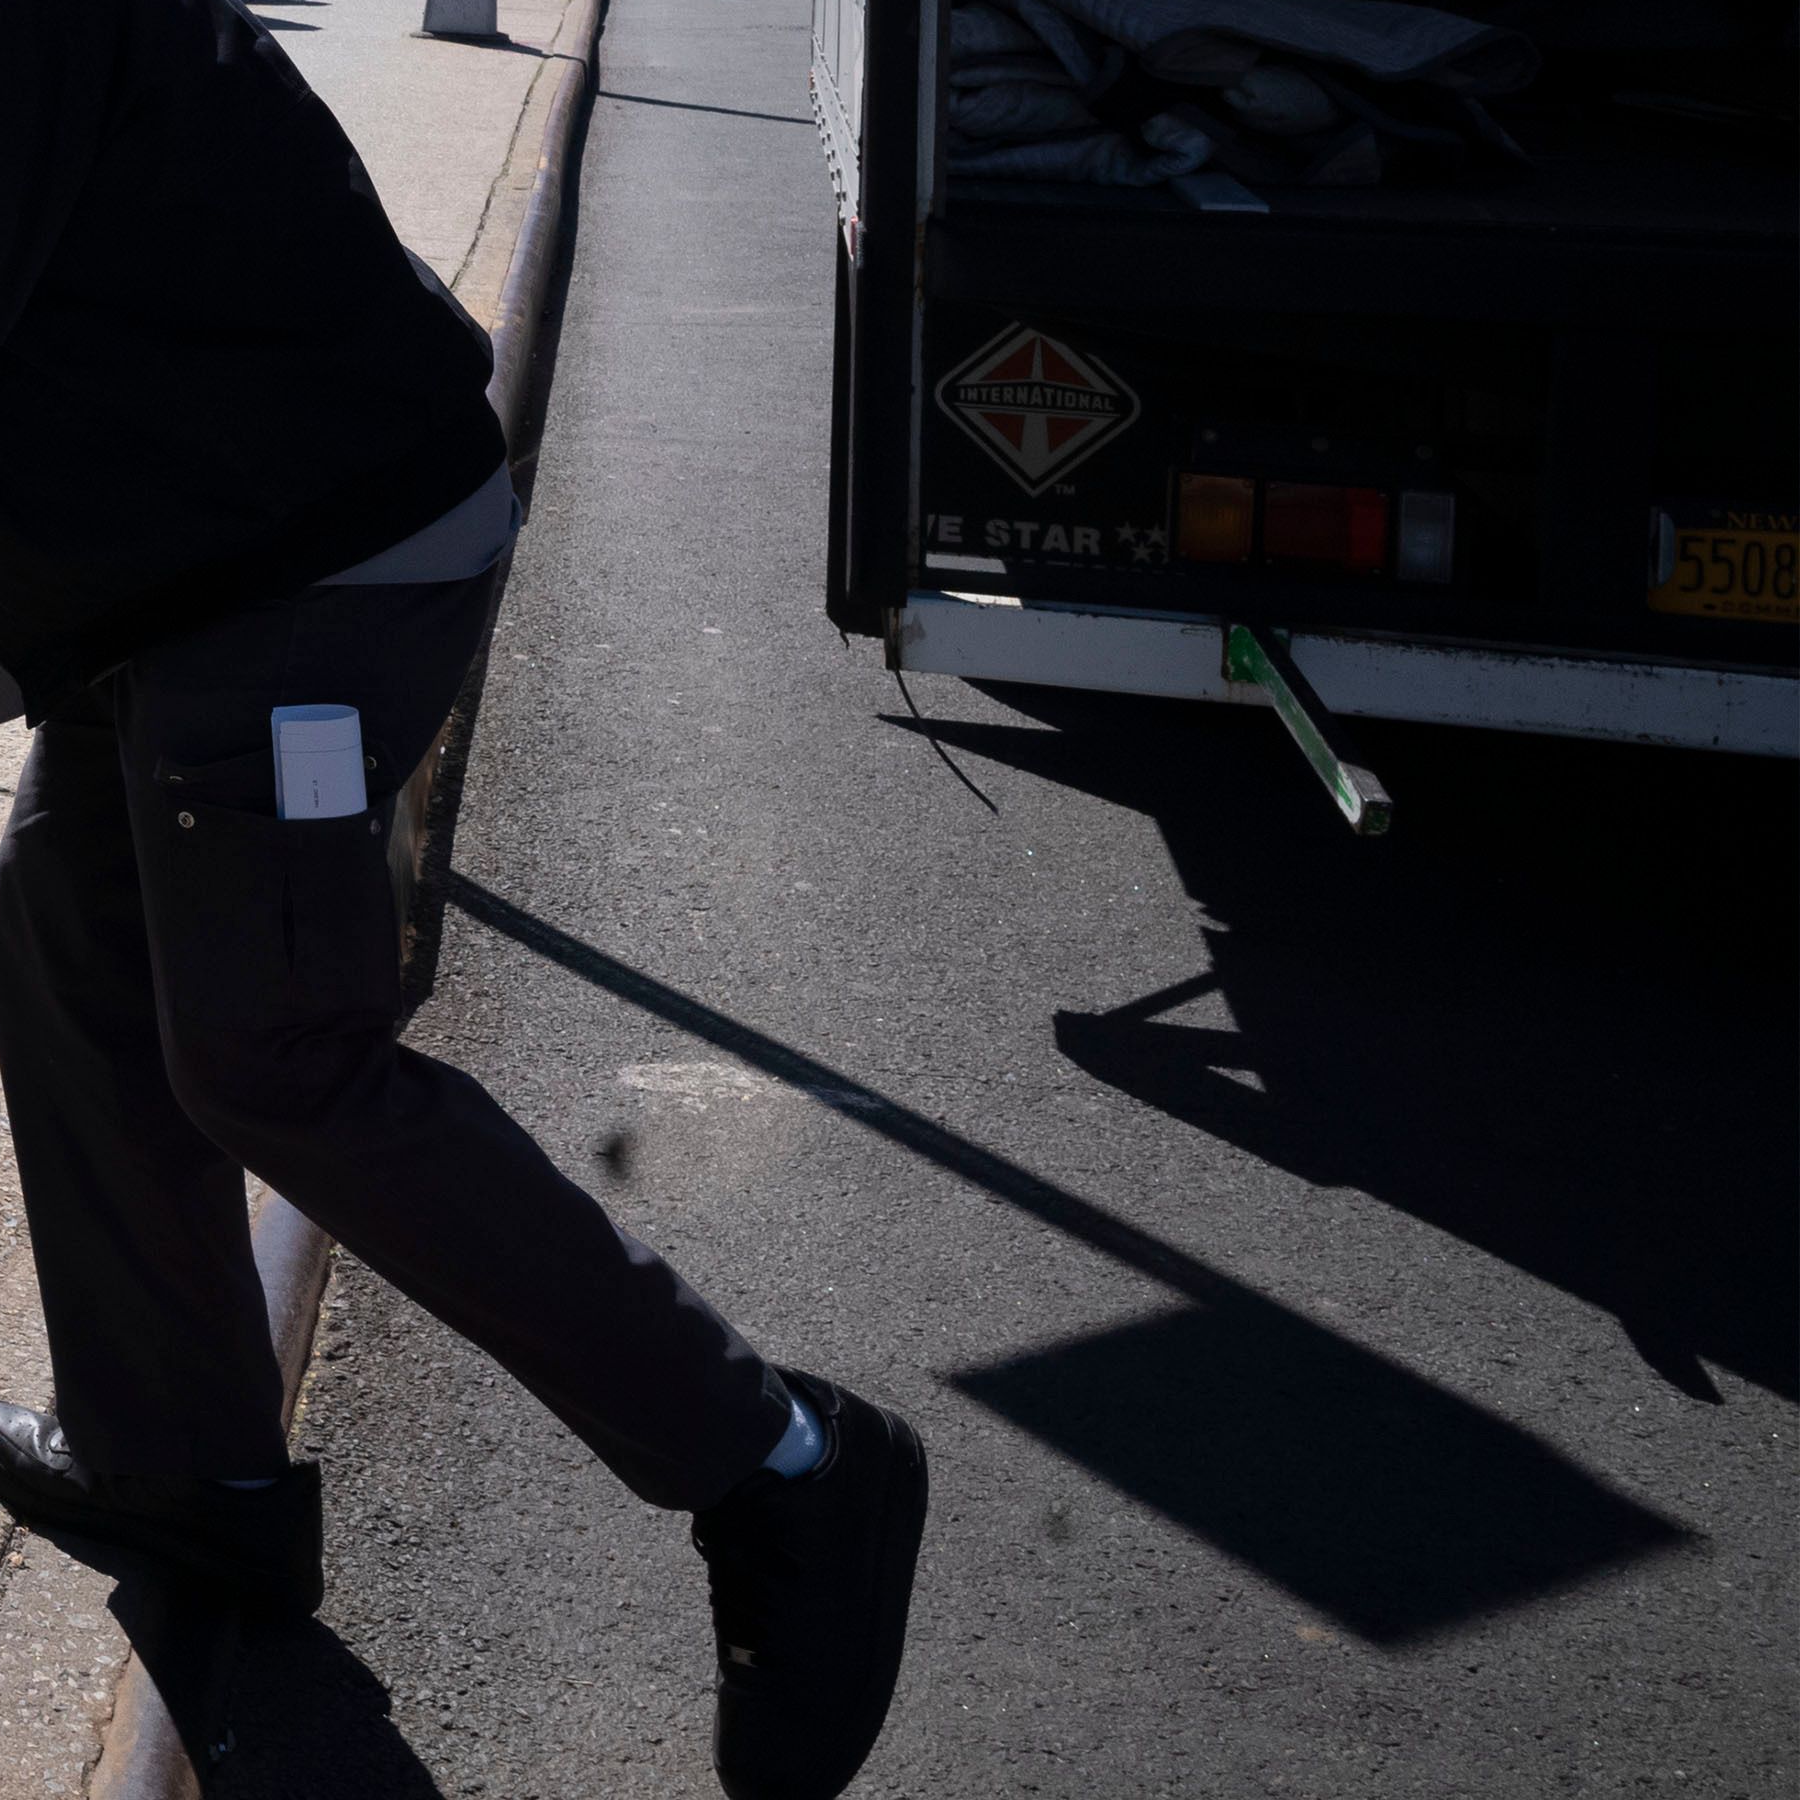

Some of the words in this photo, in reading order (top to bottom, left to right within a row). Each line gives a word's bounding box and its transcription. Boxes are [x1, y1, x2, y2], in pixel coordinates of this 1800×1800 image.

[959, 385, 1116, 411] INTERNATIONAL
[1054, 484, 1076, 496] TM
[985, 518, 1102, 555] STAR
[1679, 536, 1796, 600] 5508
